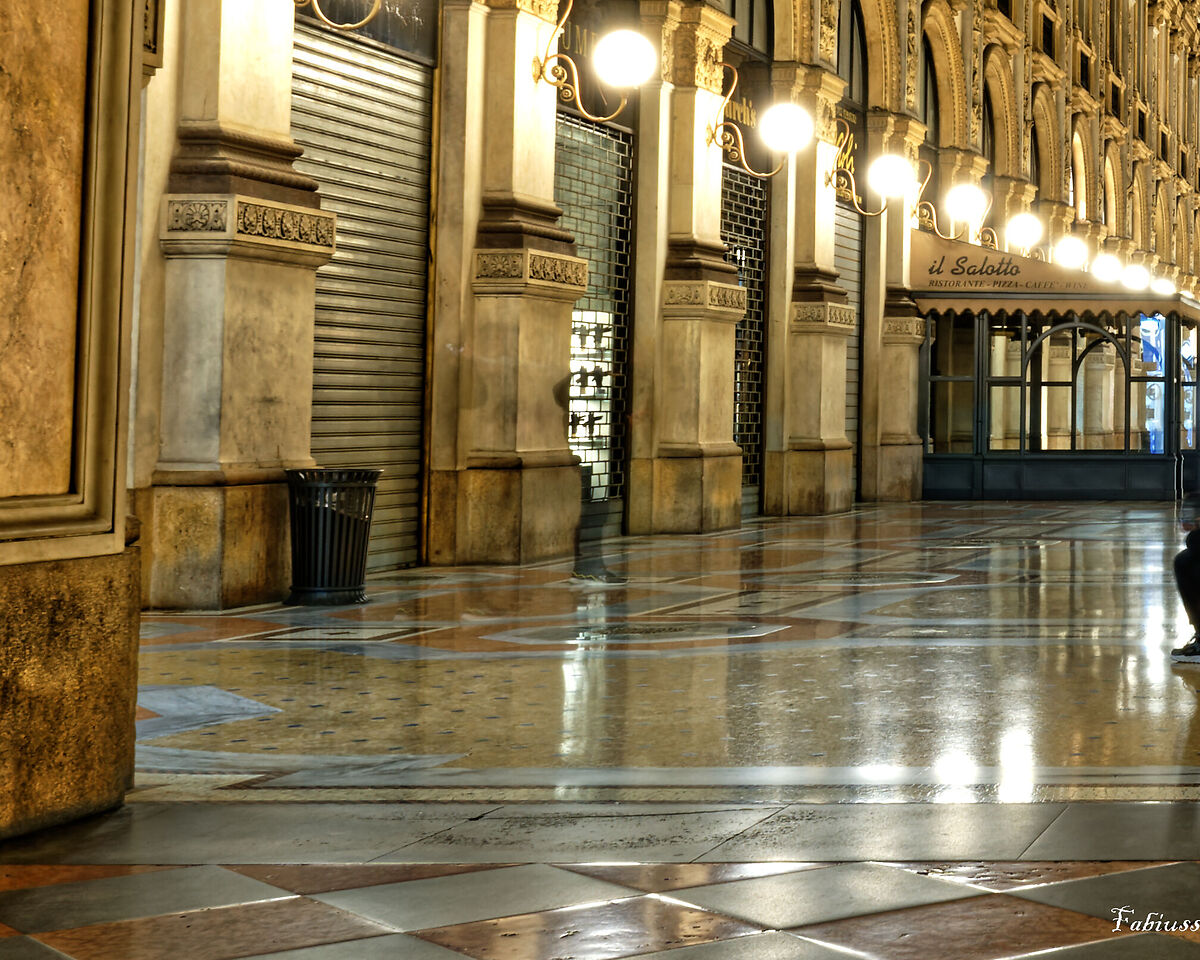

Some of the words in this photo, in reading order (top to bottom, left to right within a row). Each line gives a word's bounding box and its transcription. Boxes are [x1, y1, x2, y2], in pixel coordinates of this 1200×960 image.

[928, 255, 945, 275] il
[951, 256, 1021, 276] Salotto
[928, 279, 986, 288] RISTORANTE
[992, 280, 1019, 288] PIZZA
